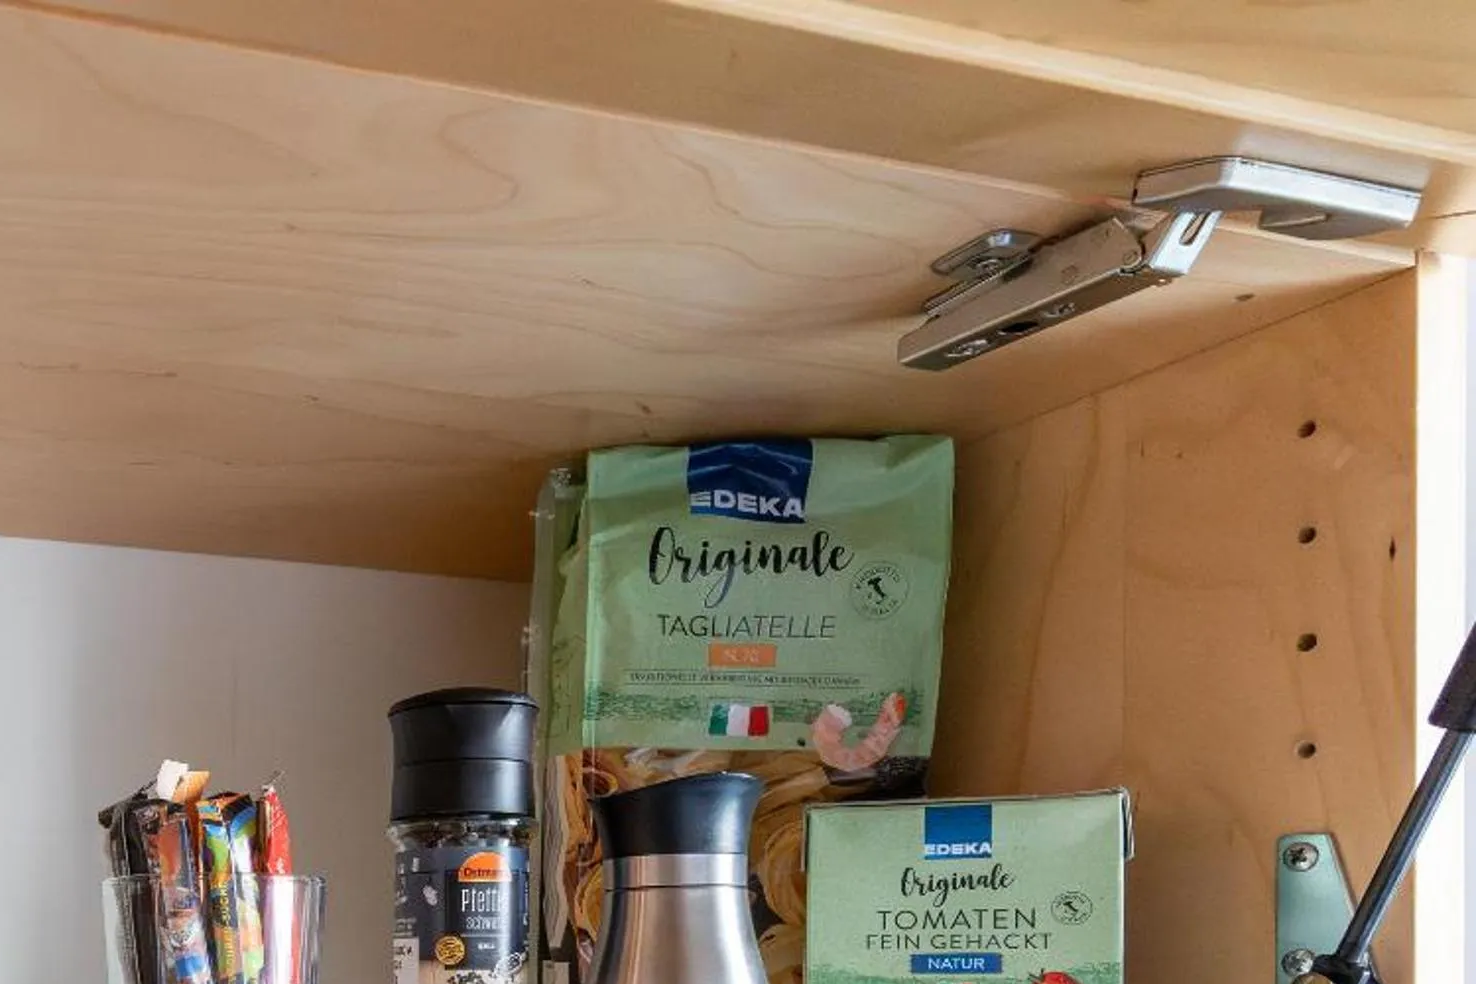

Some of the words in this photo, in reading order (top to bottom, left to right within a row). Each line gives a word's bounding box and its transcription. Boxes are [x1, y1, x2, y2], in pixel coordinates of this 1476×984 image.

[690, 490, 804, 518] EDEKA
[649, 526, 855, 608] Originale
[657, 613, 836, 638] TAGLIATELLE
[924, 842, 991, 855] EDEKA
[900, 863, 1015, 907] Originale
[877, 907, 1036, 930] TOMATEN
[866, 934, 920, 950] FEIN
[930, 932, 1052, 950] GEHACKT
[927, 957, 985, 970] NATUR
